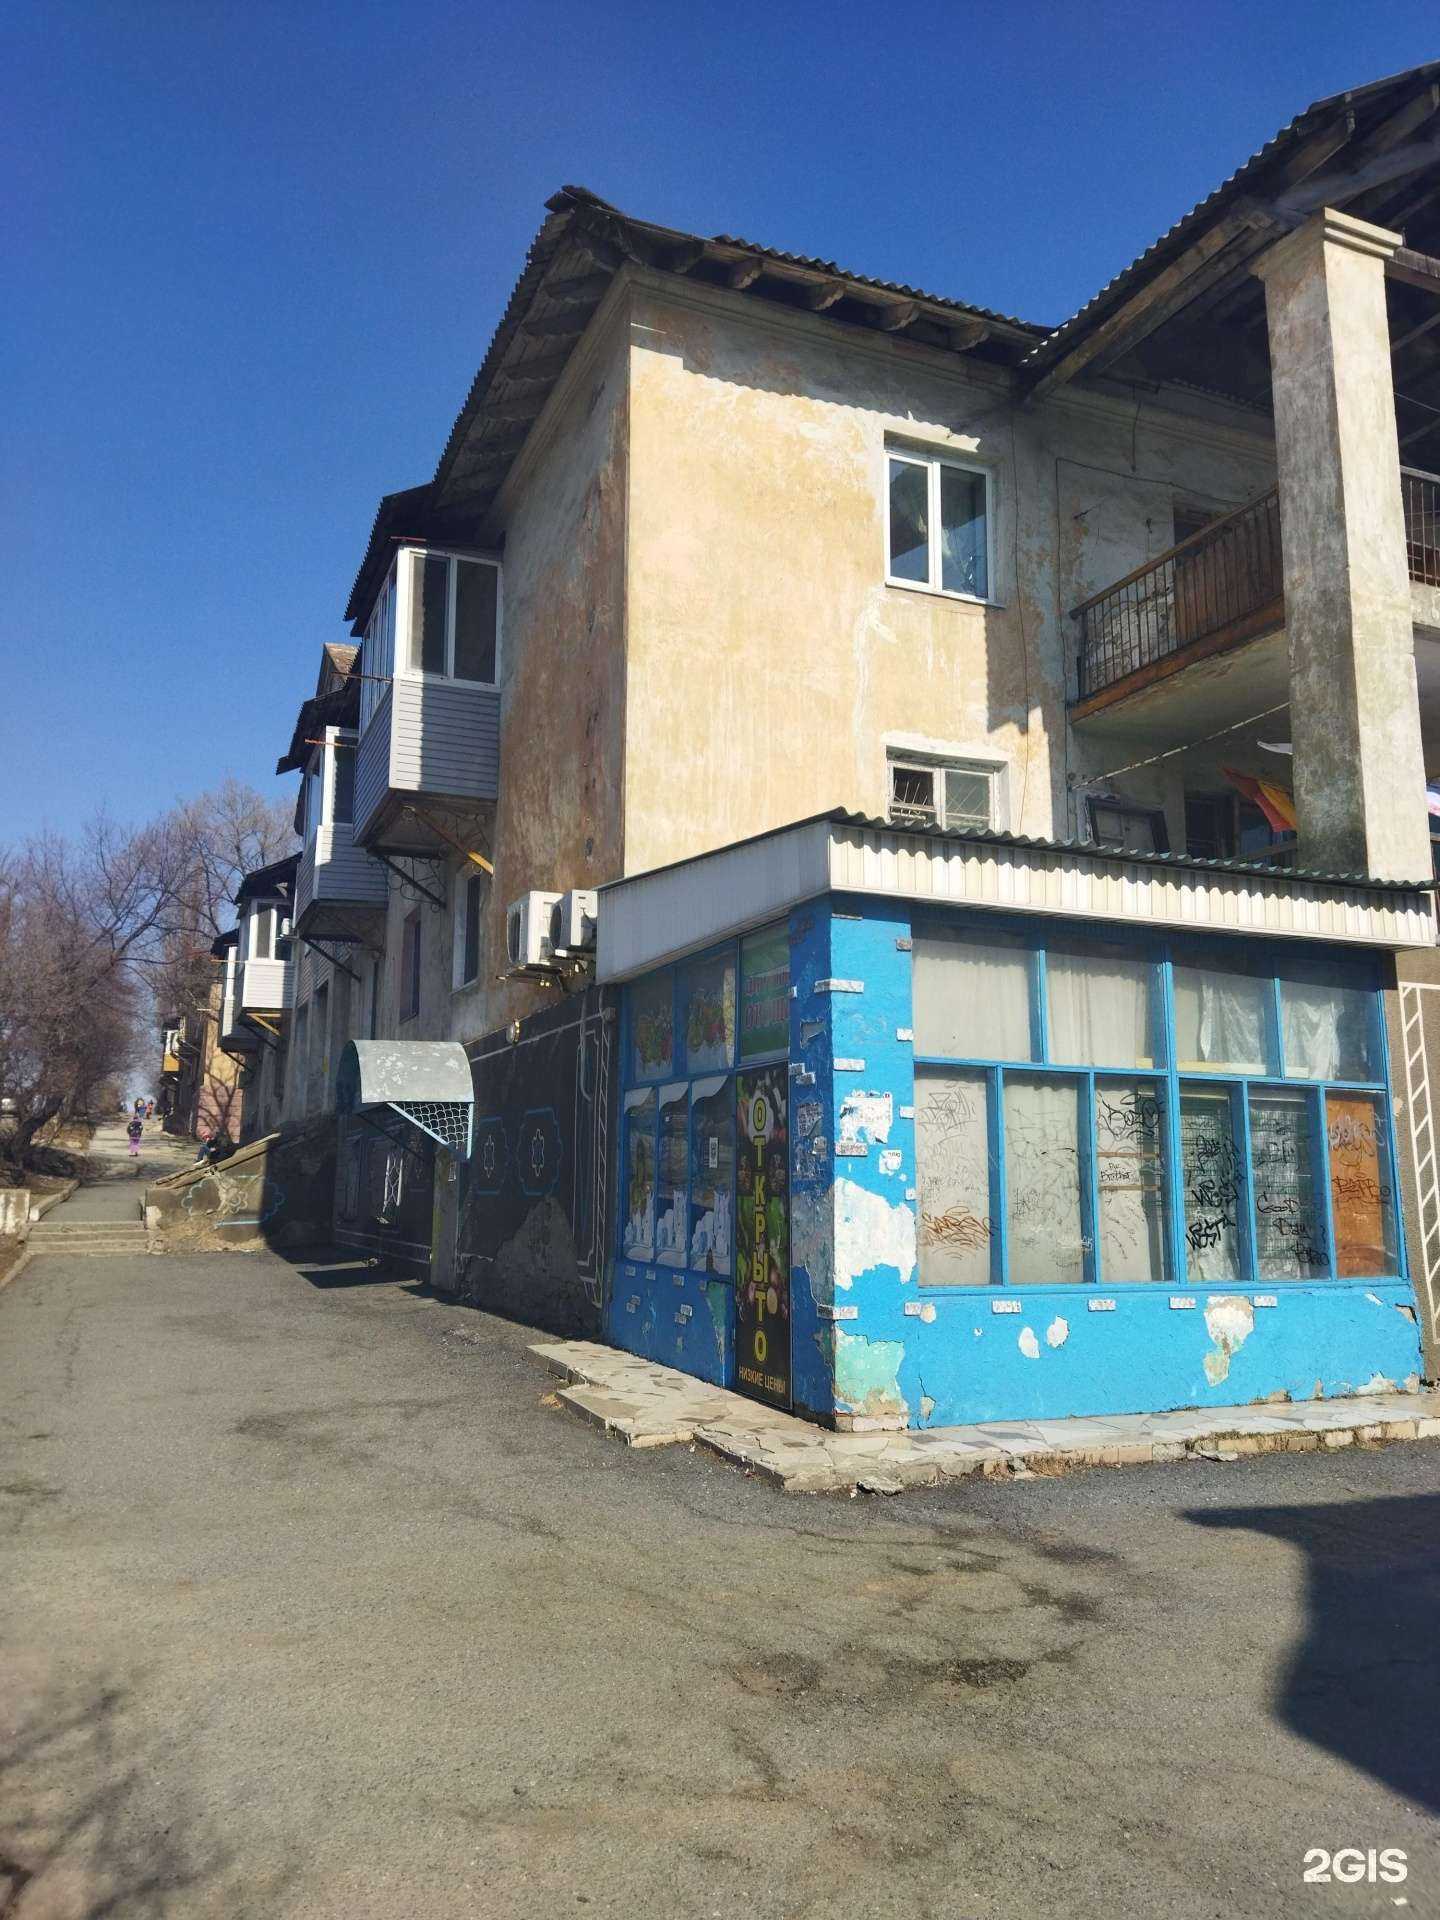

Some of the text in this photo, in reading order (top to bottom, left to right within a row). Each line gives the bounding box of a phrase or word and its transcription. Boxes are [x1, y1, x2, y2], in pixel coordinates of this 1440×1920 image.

[752, 1097, 769, 1362] ОТКРЫТО
[738, 1365, 786, 1393] НИЗКИЕ ЦЕНЫ
